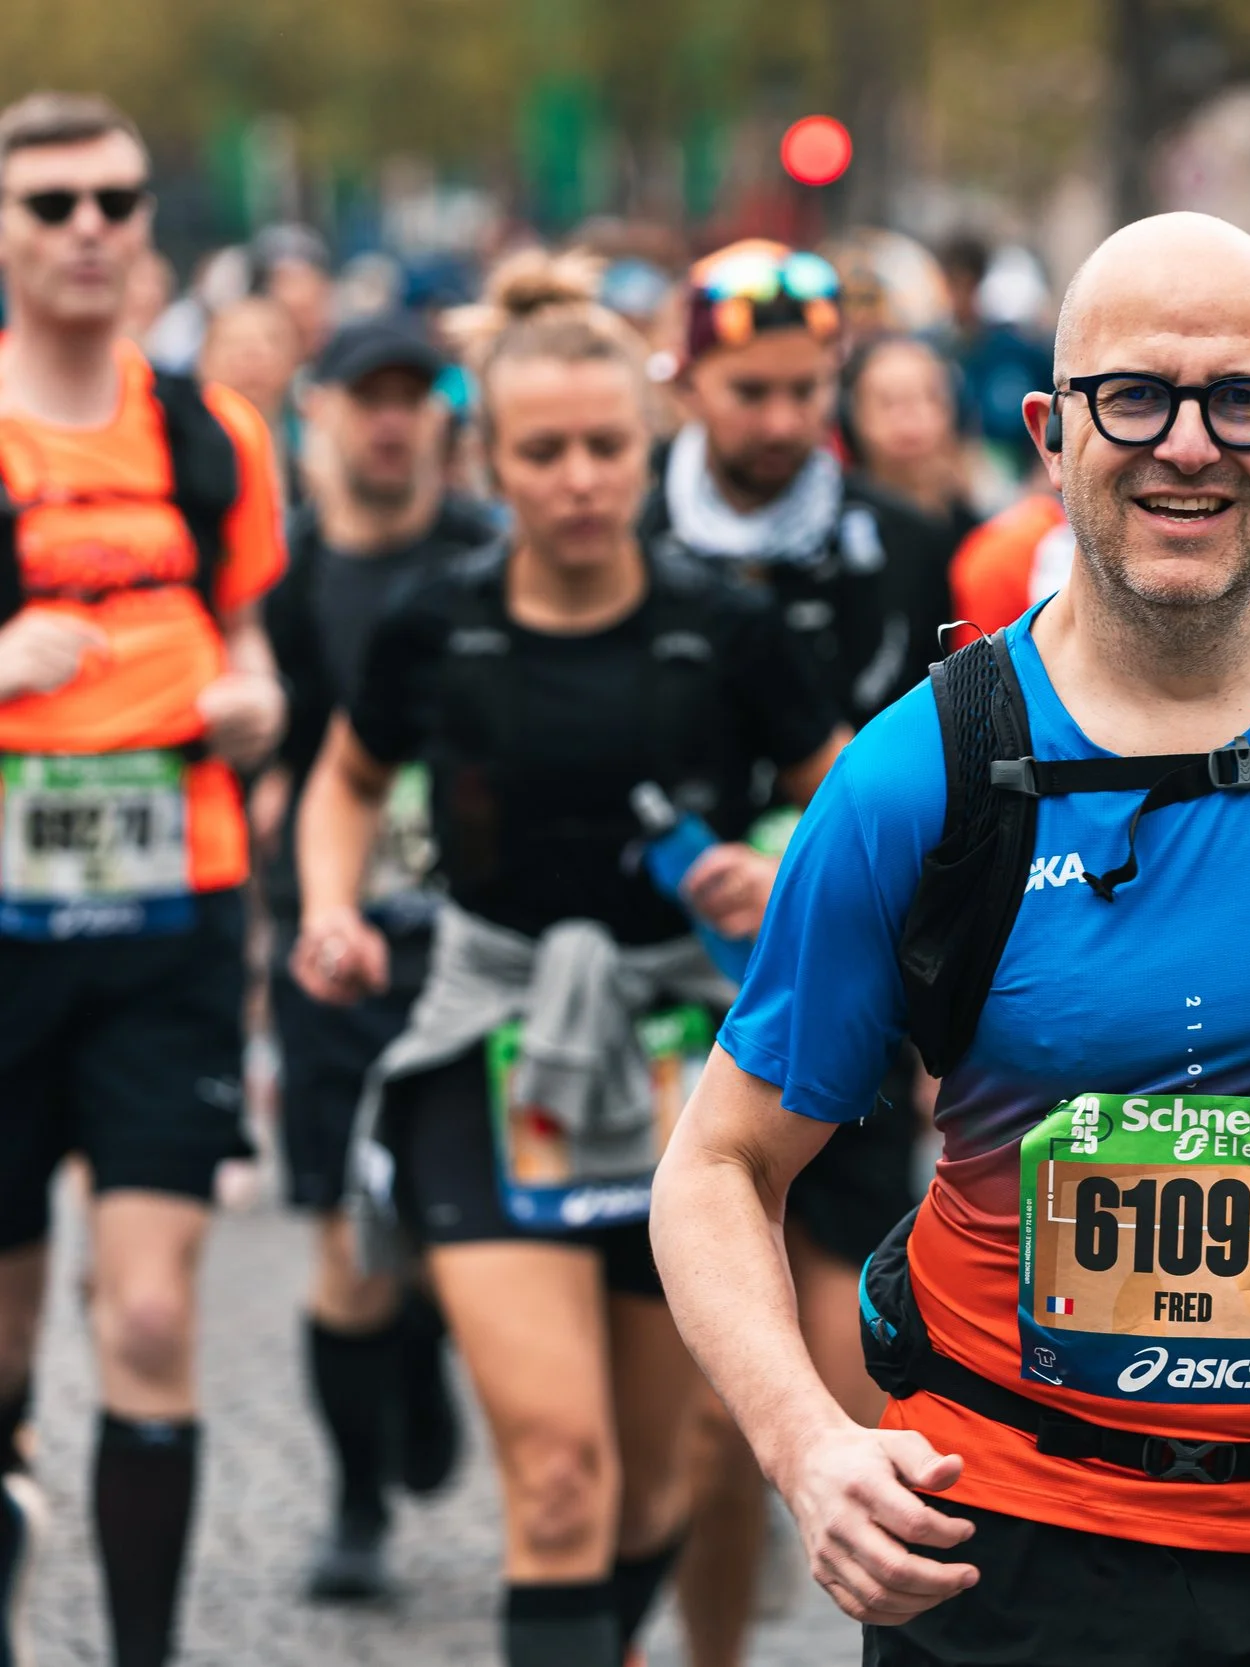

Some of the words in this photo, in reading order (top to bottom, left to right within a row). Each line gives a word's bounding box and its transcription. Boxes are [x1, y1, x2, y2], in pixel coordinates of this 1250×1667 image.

[1071, 1096, 1100, 1126] 20
[1070, 1125, 1098, 1155] 25
[1154, 1291, 1212, 1323] FRED
